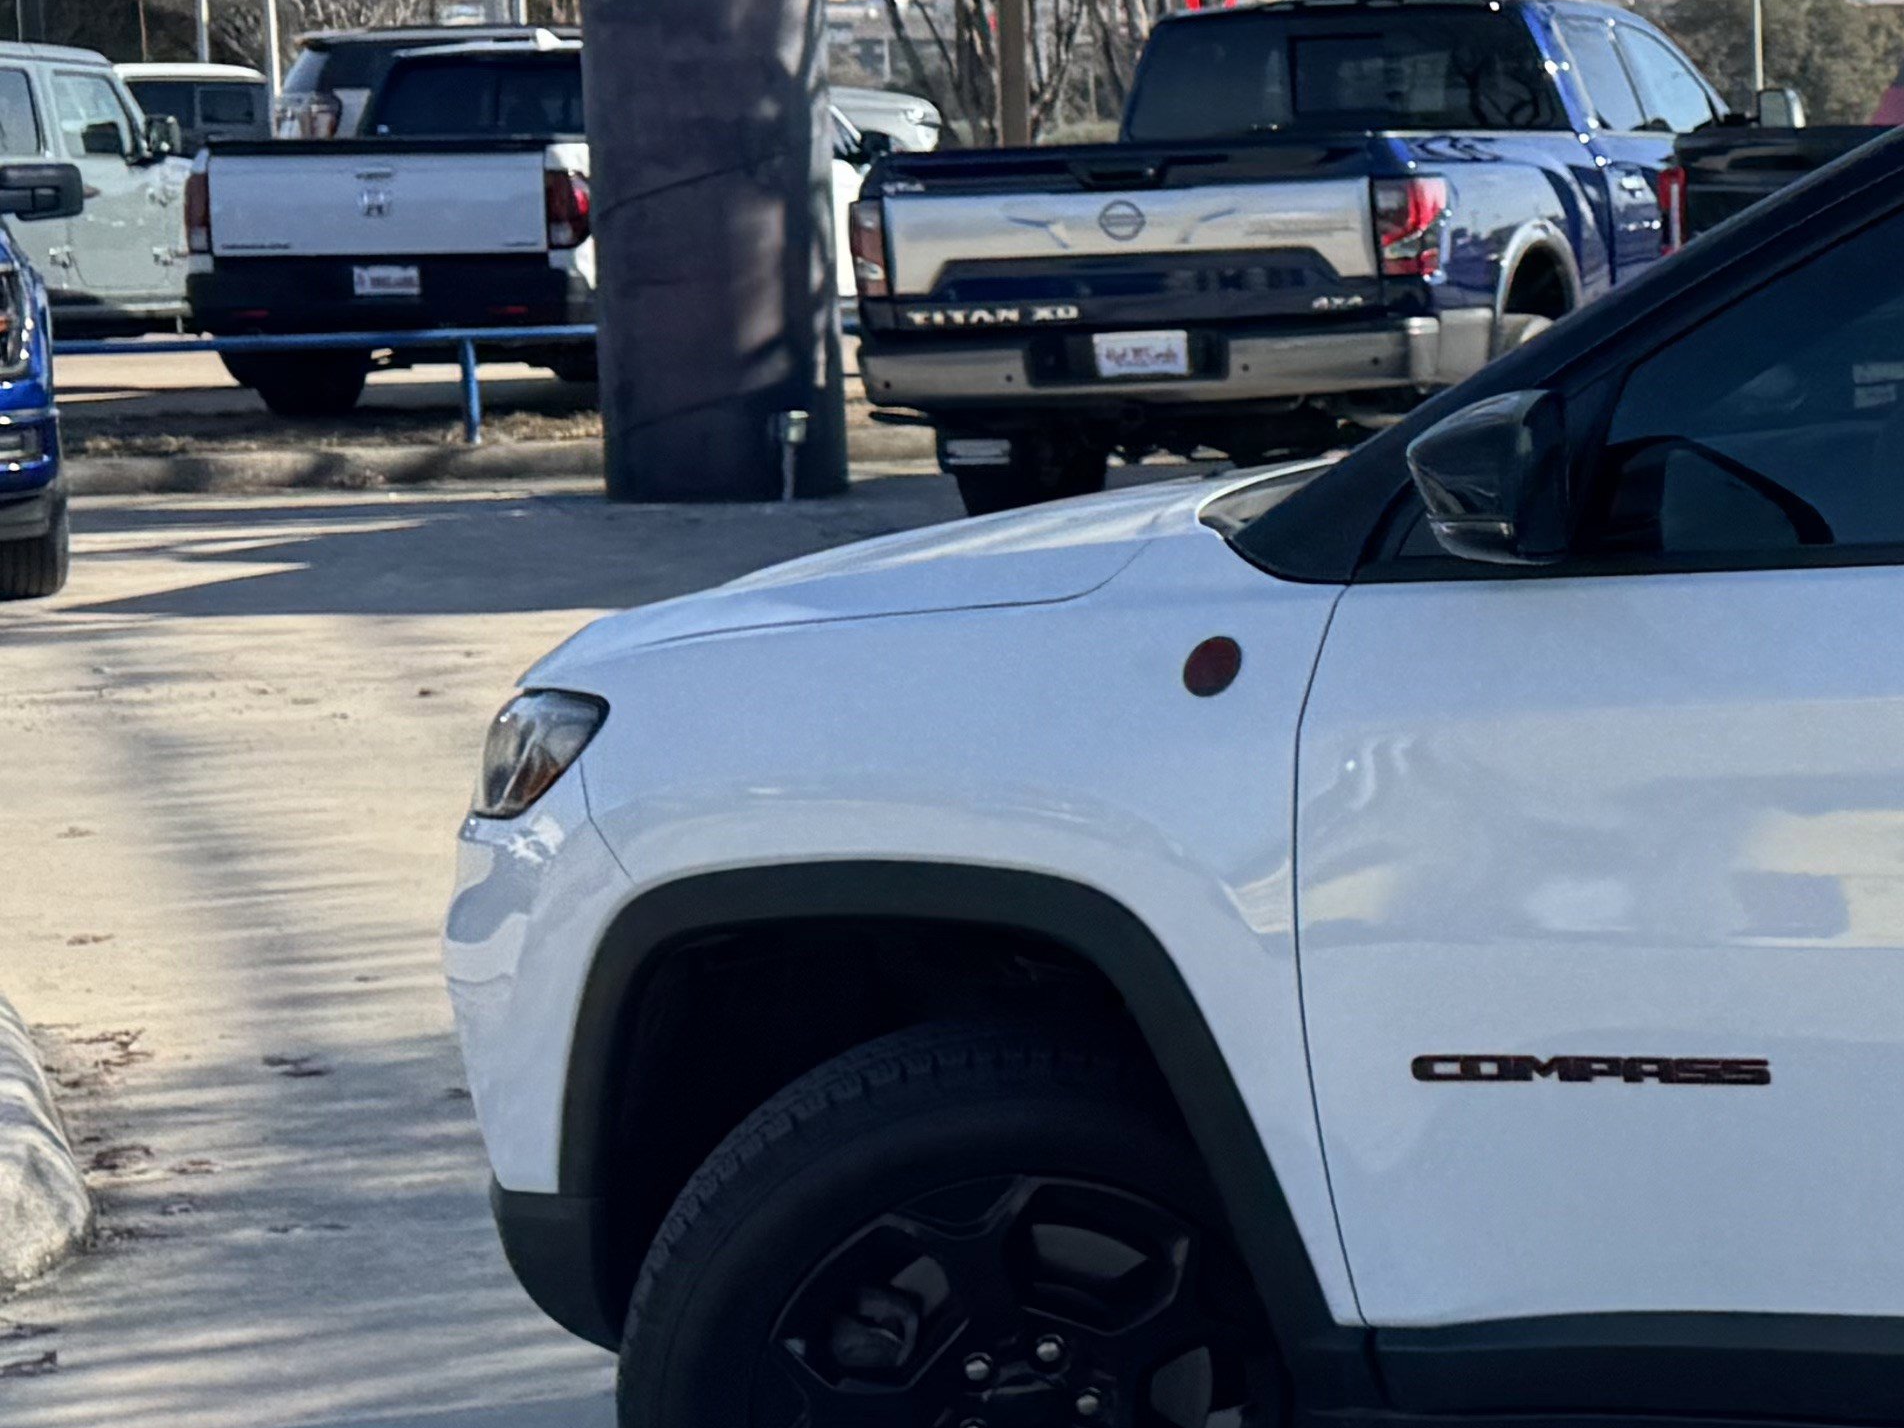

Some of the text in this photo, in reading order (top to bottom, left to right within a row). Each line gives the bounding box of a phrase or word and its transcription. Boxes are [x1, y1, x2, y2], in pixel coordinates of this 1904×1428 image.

[907, 305, 1079, 325] TITAN XD
[1411, 1054, 1771, 1085] COMPASS
